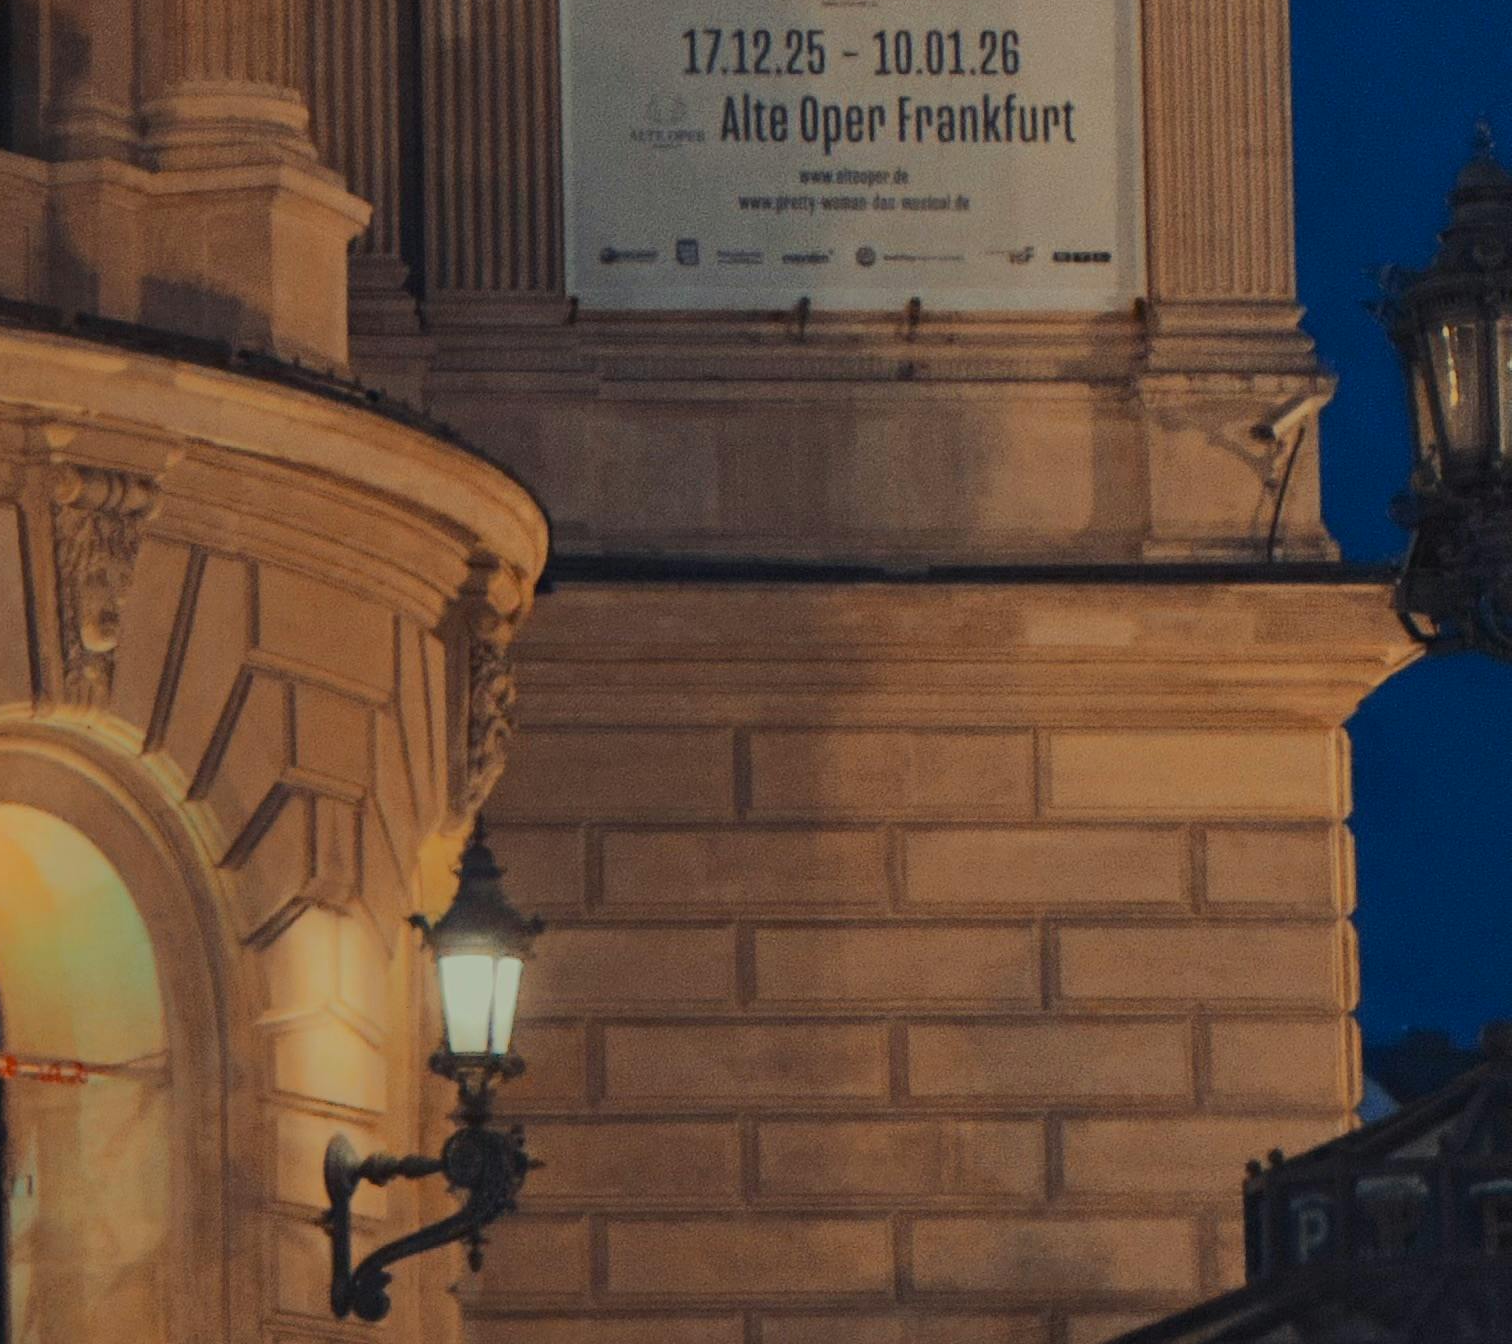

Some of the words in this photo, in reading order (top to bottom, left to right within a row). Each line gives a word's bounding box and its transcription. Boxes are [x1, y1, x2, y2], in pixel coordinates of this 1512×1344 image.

[683, 29, 826, 76] 17.12.25
[873, 29, 1021, 77] 10.01.26
[720, 93, 788, 144] Alte
[800, 94, 888, 156] Oper
[898, 93, 1077, 145] Frankfurt
